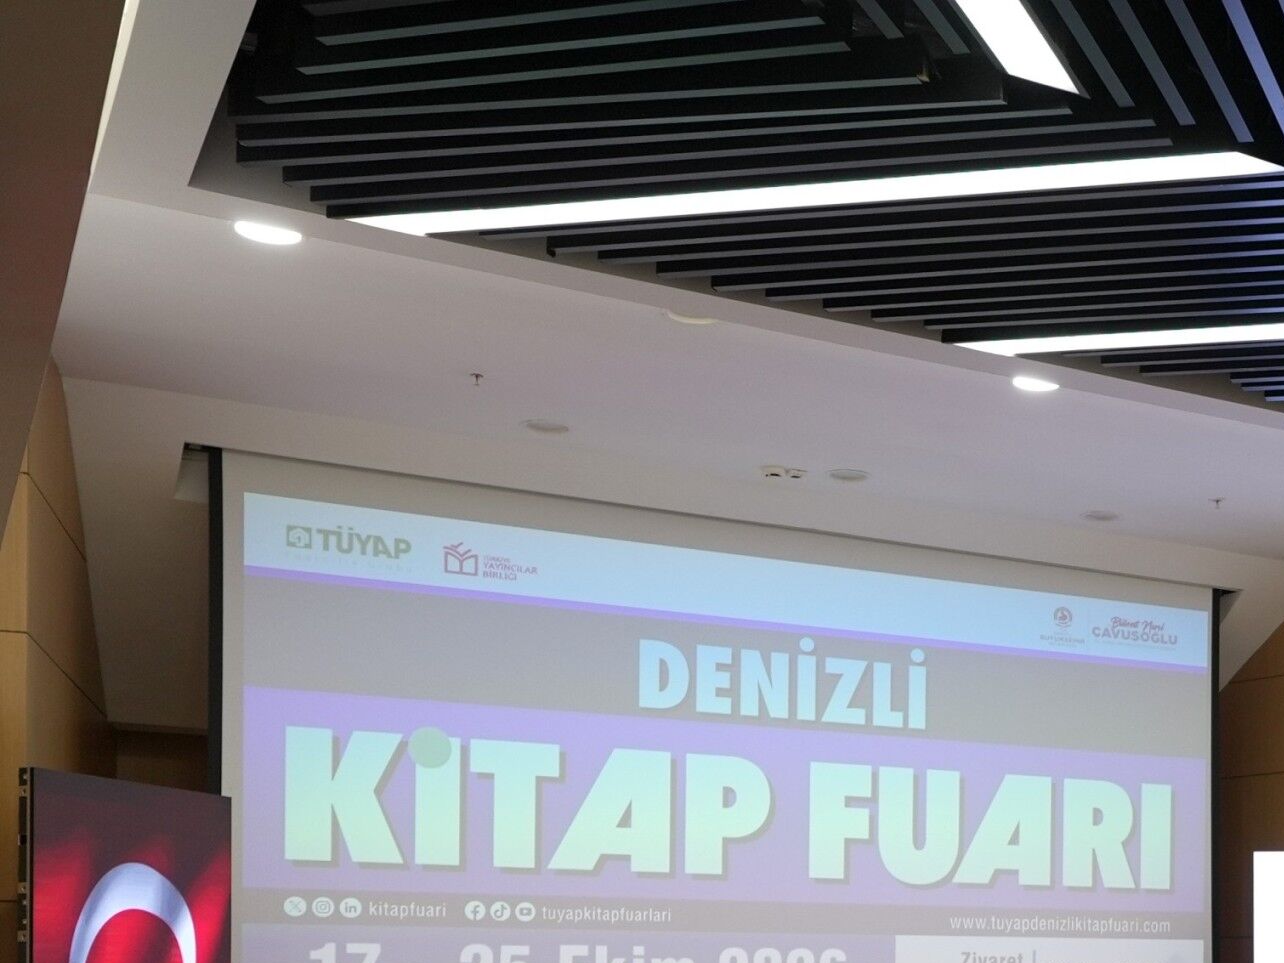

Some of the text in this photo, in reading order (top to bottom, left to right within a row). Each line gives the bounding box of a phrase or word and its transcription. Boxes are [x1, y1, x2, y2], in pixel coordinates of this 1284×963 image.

[316, 525, 411, 559] TÜYAP
[638, 637, 927, 730] DENİZLİ
[284, 725, 1174, 892] KİTAP FUARI
[368, 901, 447, 921] kitapfuari
[950, 915, 1171, 934] www.tuyapdenizlikitapfuari.com
